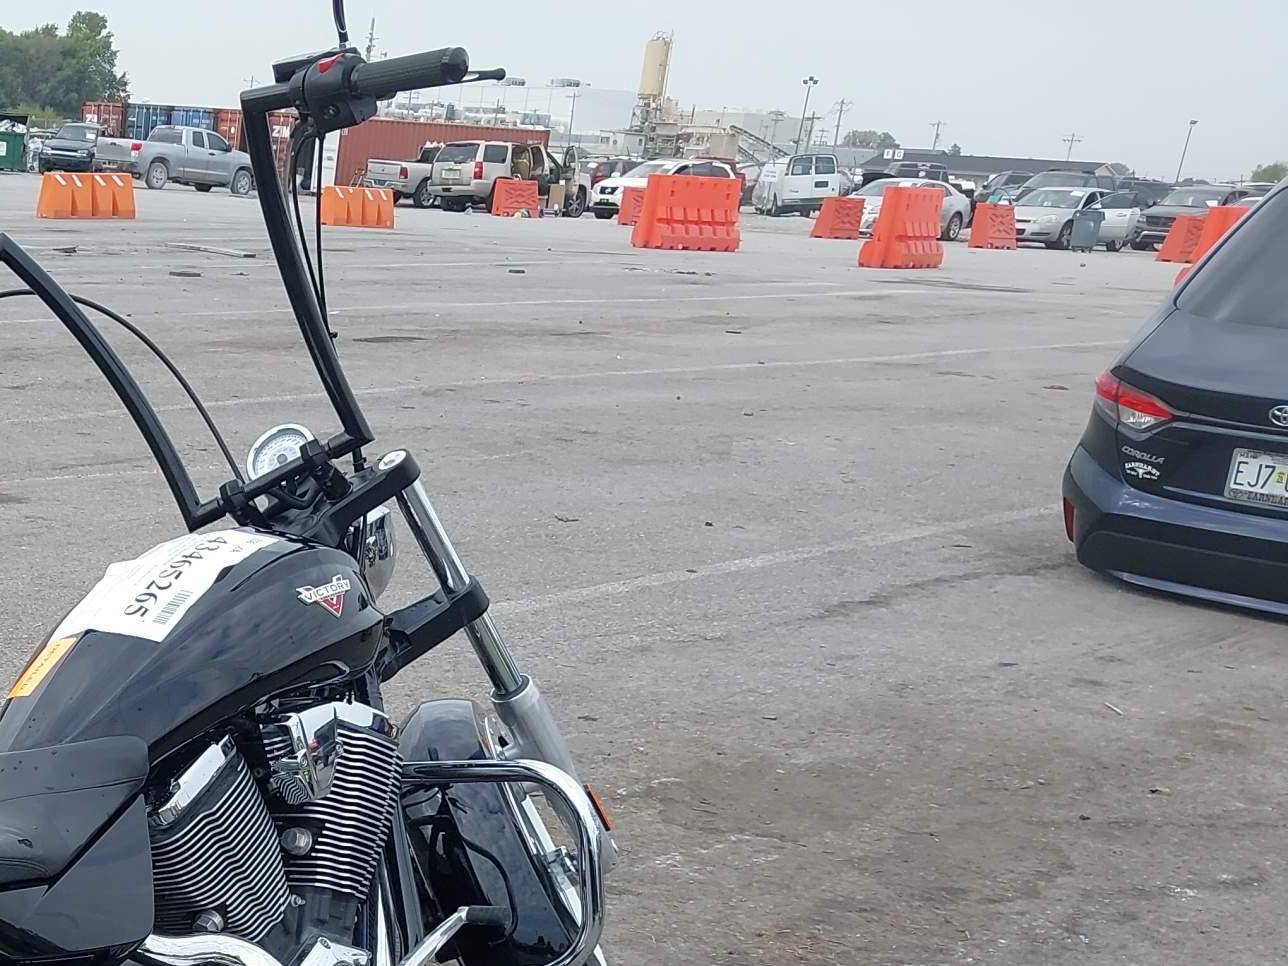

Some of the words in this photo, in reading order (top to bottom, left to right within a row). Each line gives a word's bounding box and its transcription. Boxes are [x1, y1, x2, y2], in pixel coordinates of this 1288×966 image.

[272, 125, 290, 138] ZIM
[1121, 445, 1165, 464] COROLLA
[124, 536, 228, 618] 43465265
[304, 581, 349, 601] VICTORY
